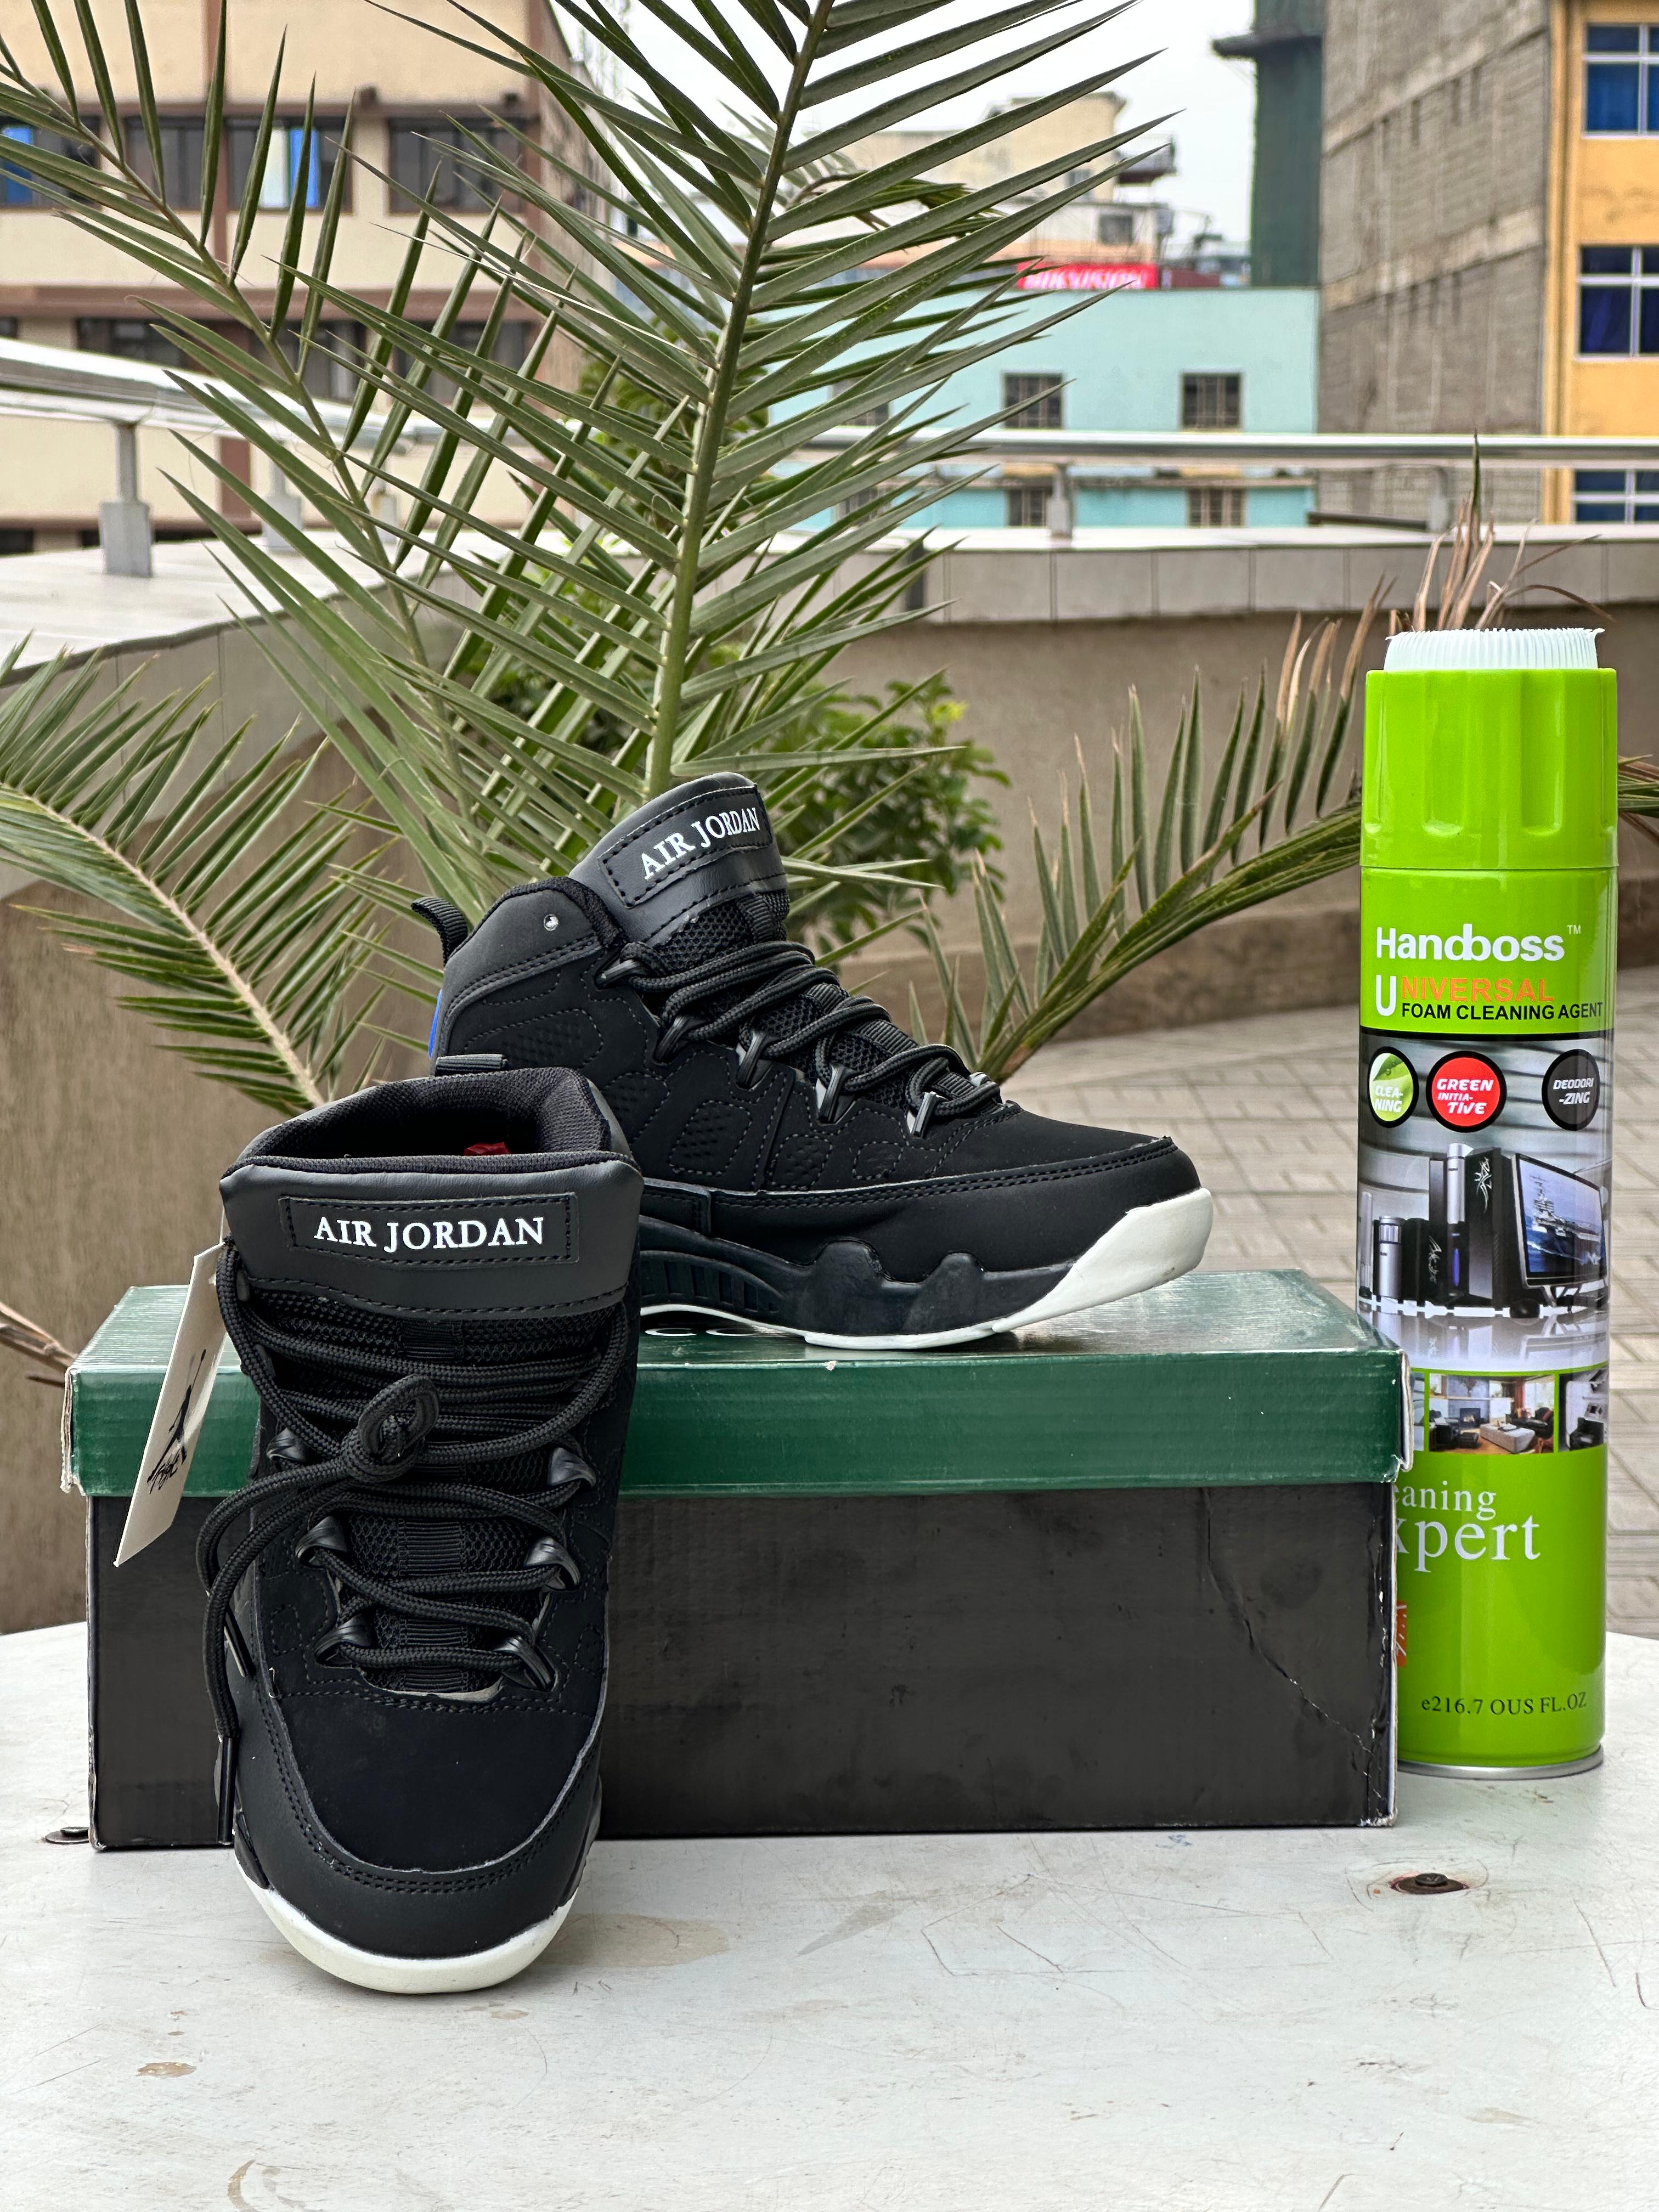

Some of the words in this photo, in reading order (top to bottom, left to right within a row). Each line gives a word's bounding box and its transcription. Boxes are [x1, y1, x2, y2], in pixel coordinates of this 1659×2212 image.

[641, 833, 696, 881] AIR
[692, 807, 760, 848] JORDAN
[1375, 923, 1565, 962] Handboss
[1402, 1003, 1451, 1019] FOAM
[1456, 1005, 1554, 1020] CLEANING
[1558, 1002, 1603, 1019] AGENT
[1436, 1078, 1494, 1091] GREEN
[1553, 1077, 1594, 1090] DEODORI
[1437, 1092, 1474, 1101] INITIA-
[1374, 1098, 1402, 1113] NING
[1447, 1102, 1487, 1114] TIVE
[313, 1216, 377, 1247] AIR
[383, 1216, 544, 1253] JORDAN
[1421, 1696, 1483, 1714] e216.7
[1489, 1699, 1534, 1715] OUS
